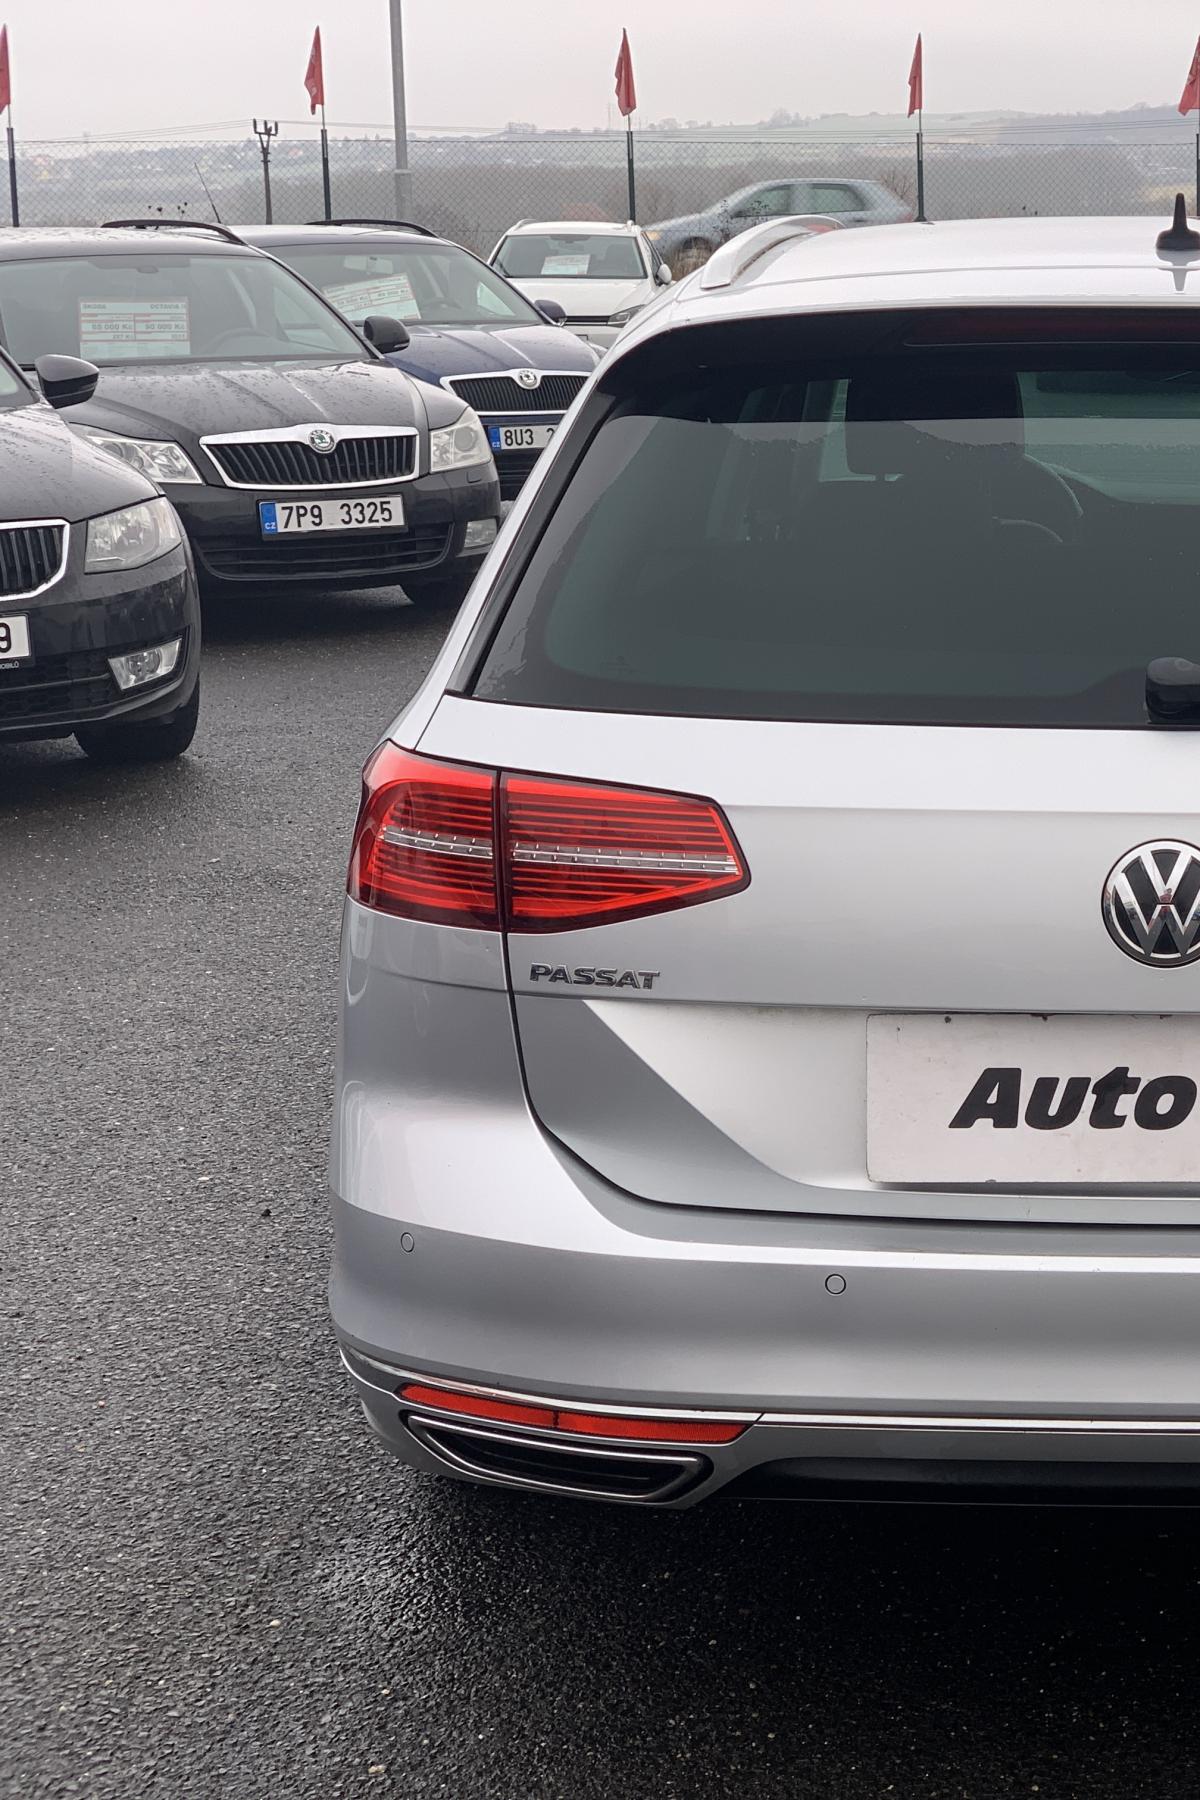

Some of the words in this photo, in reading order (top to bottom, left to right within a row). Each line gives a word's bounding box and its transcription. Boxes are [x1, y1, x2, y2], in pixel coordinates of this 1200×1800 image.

[504, 428, 534, 446] 8U3
[281, 504, 323, 529] 7P9
[340, 501, 392, 525] 3325
[0, 622, 12, 653] 9
[529, 962, 660, 990] PASSAT
[948, 1066, 1198, 1131] Auto
